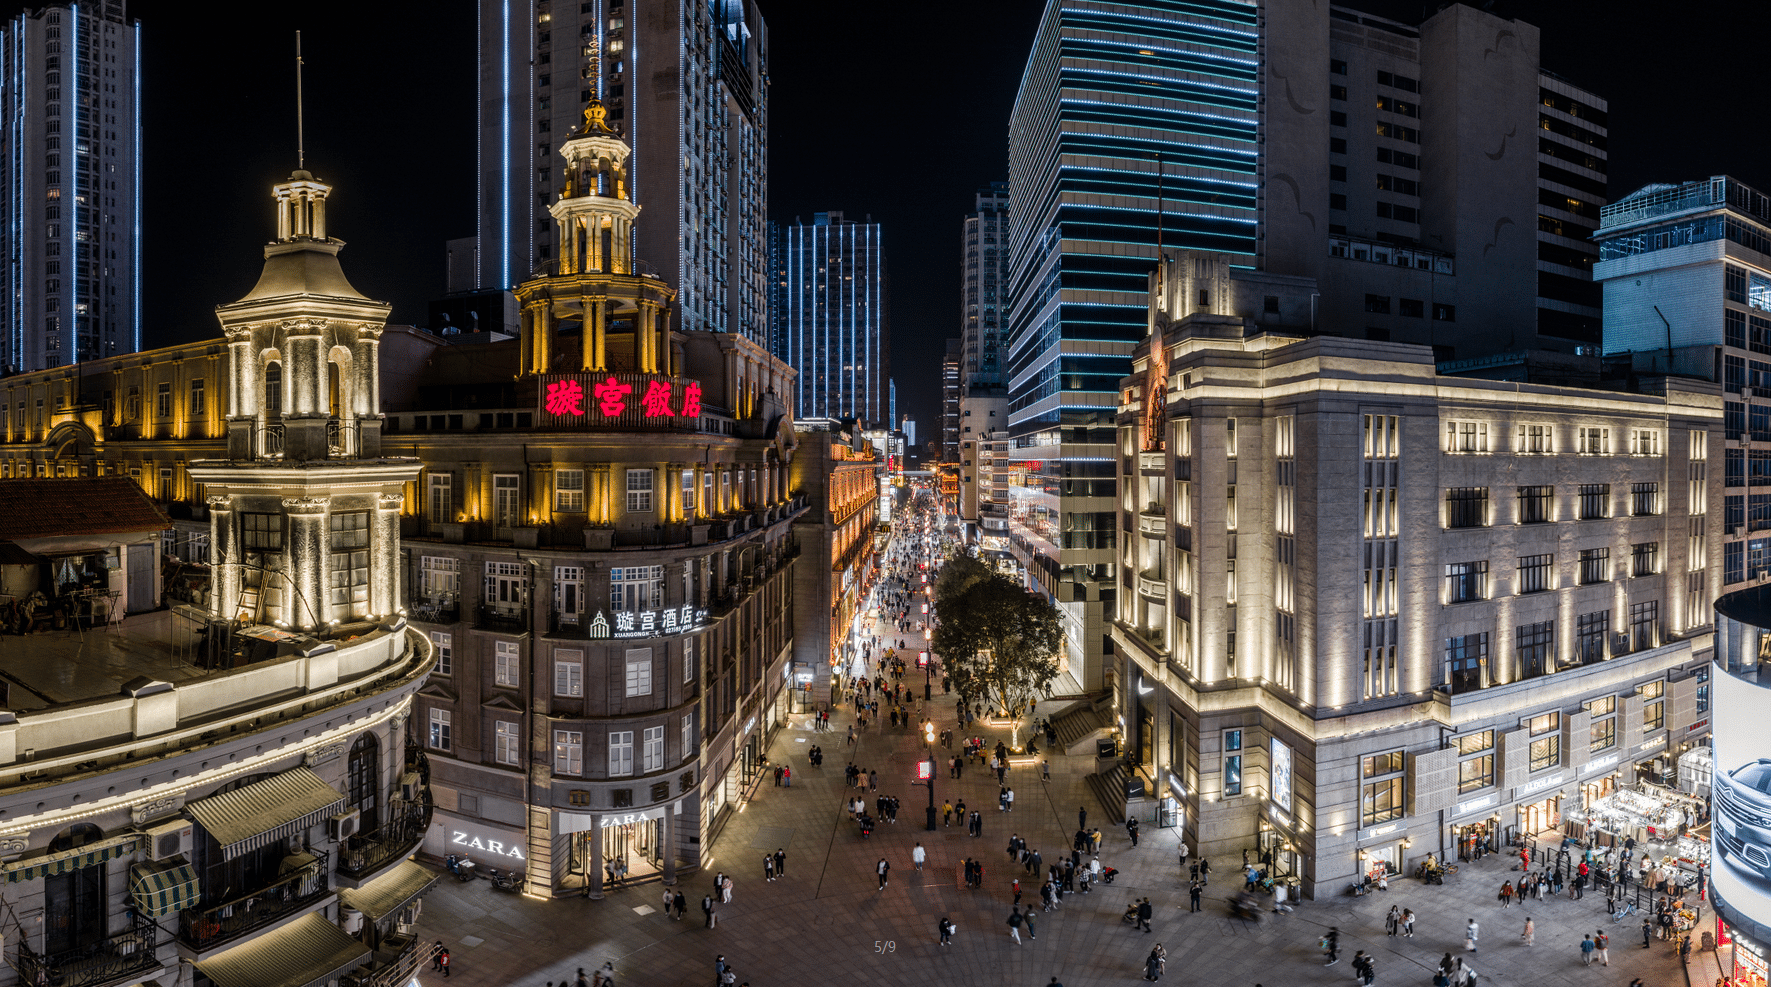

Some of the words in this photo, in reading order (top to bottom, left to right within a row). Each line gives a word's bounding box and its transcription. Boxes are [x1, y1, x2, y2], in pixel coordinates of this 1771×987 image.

[616, 604, 693, 632] 璇宫酒店
[601, 812, 649, 828] ZARA
[452, 831, 525, 860] ZARA
